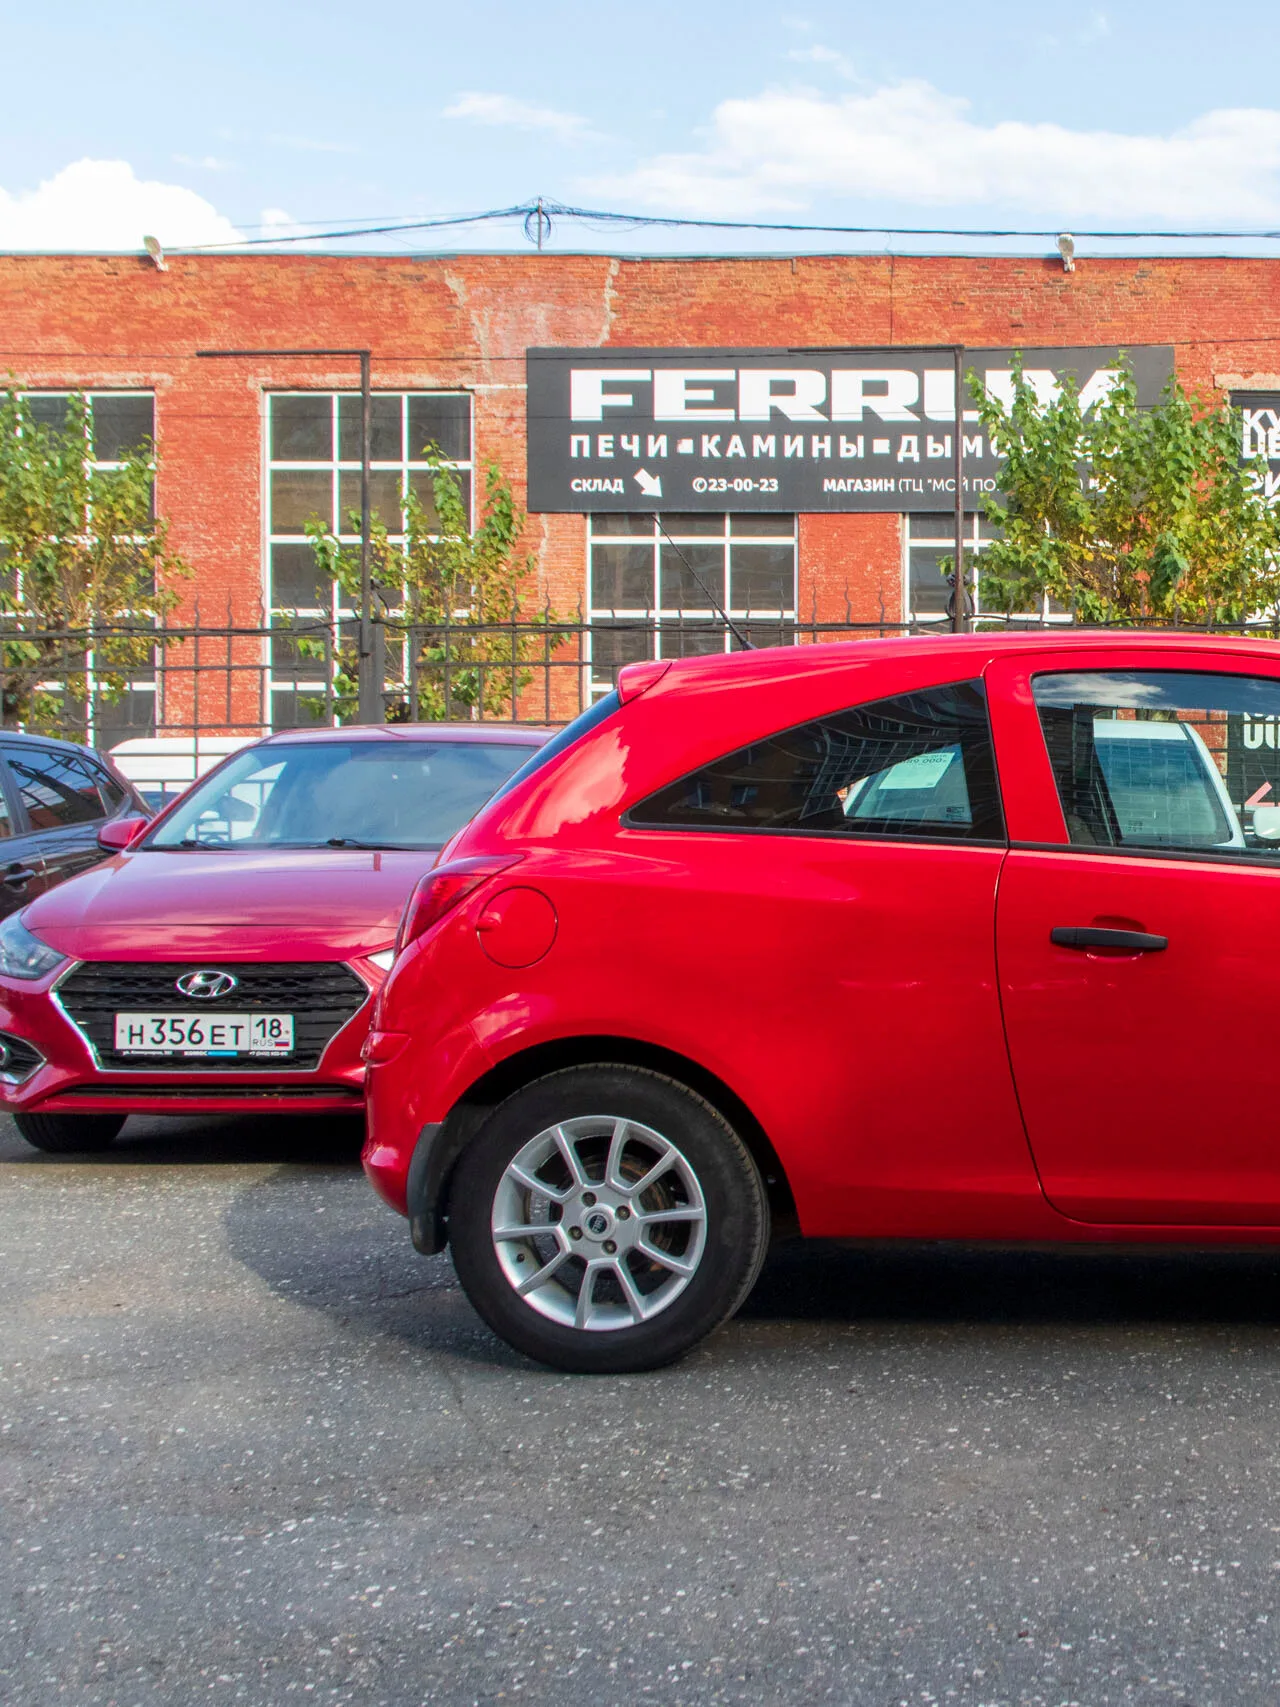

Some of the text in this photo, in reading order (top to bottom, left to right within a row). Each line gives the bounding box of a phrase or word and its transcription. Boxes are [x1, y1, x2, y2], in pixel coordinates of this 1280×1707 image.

[570, 434, 668, 458] ПЕЧИ
[701, 434, 865, 458] КАМИНЫ
[570, 478, 625, 494] СКЛАД
[823, 478, 895, 492] МАГАЗИН
[898, 478, 924, 493] (ТЦ
[128, 1018, 282, 1046] Н356ЕТ 18
[252, 1038, 274, 1047] RUS
